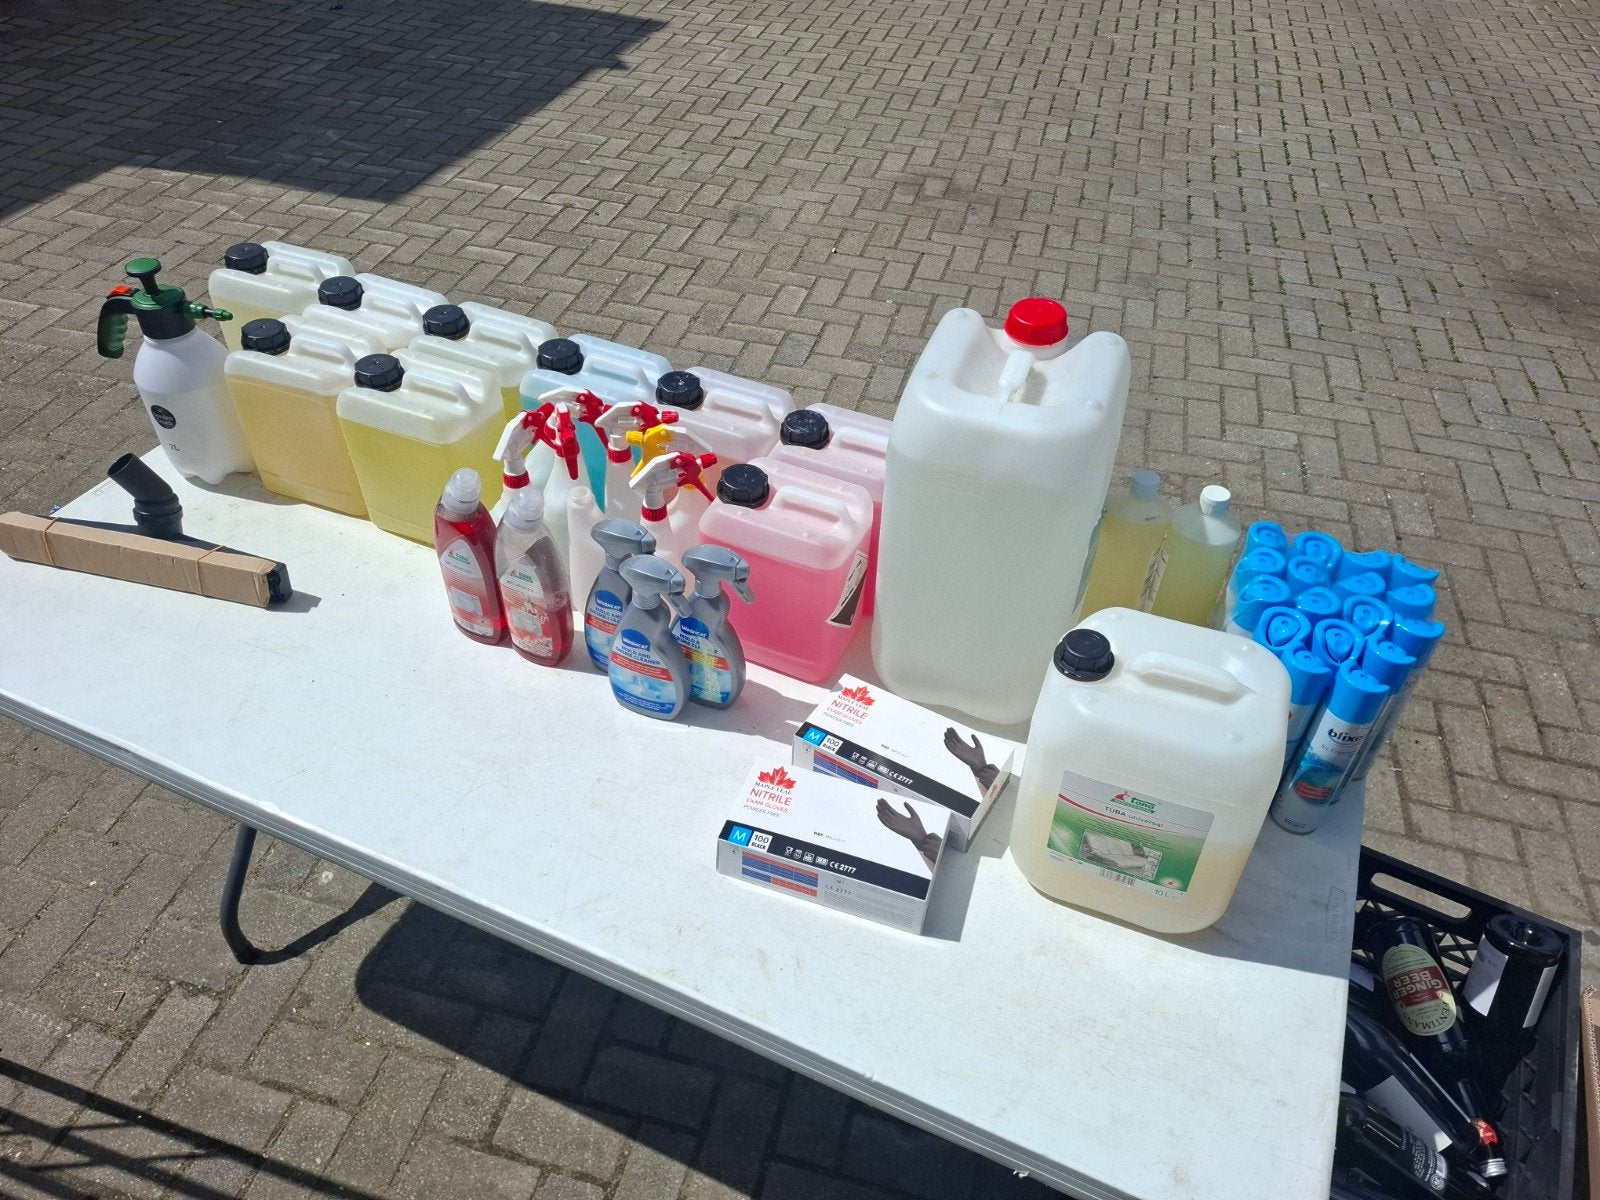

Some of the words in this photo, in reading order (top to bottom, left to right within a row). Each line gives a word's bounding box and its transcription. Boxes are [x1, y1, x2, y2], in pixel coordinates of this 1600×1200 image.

[622, 636, 648, 649] WASHCAT
[831, 699, 869, 720] NITRILE
[808, 731, 821, 741] M
[826, 737, 840, 747] 100
[823, 743, 836, 752] BLACK
[750, 787, 793, 806] NITRILE
[1130, 796, 1157, 810] tana
[764, 801, 789, 813] GLOVES
[1104, 805, 1127, 817] TUBA
[1128, 814, 1164, 829] universal
[733, 830, 747, 843] M
[754, 834, 770, 844] 100
[751, 841, 767, 850] BLACK
[839, 863, 857, 874] 2777
[1393, 970, 1432, 988] BEER
[1392, 979, 1443, 1000] GINGER
